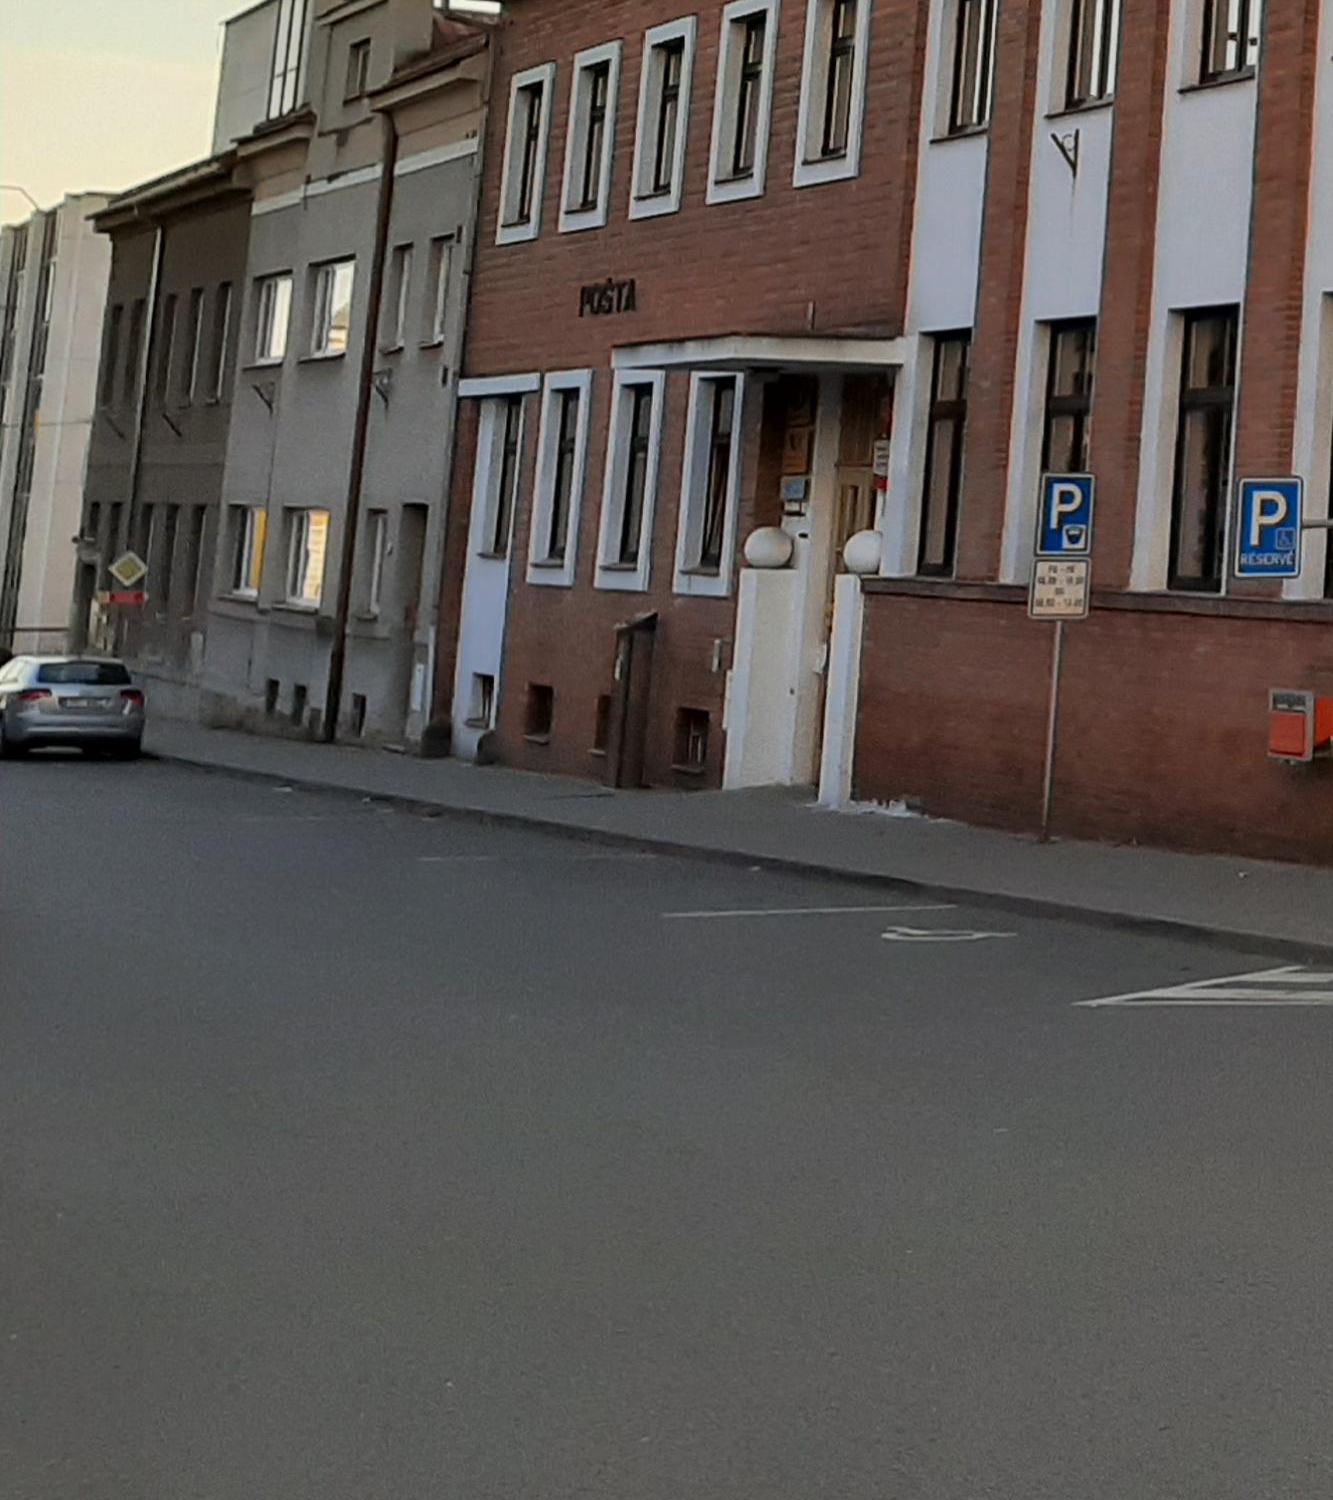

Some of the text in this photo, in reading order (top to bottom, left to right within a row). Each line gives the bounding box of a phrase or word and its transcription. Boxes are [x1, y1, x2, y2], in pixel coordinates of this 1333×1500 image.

[578, 277, 636, 318] POŠTA
[1049, 482, 1083, 530] P
[1249, 489, 1288, 547] P
